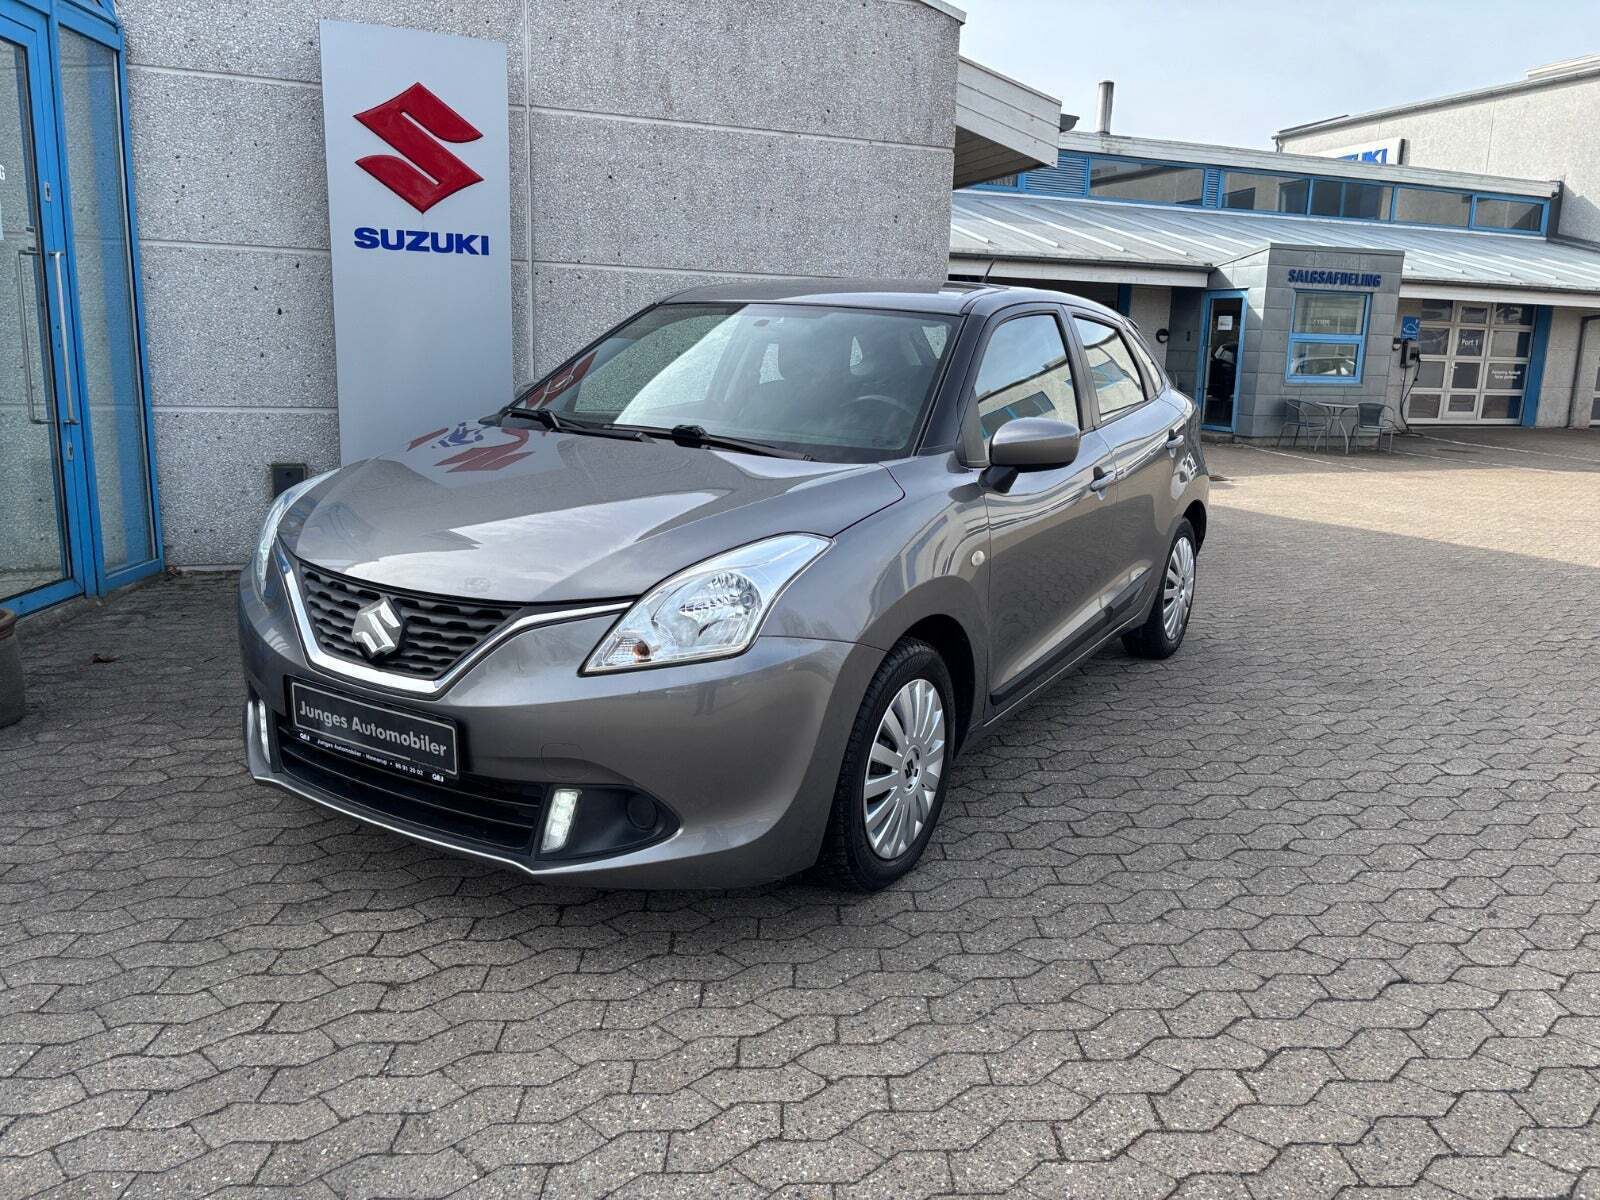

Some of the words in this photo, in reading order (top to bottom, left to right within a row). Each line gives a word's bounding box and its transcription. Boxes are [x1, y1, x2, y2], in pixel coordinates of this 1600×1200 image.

[354, 227, 490, 256] SUZUKI
[1288, 268, 1382, 288] SALGSAFDELING
[1461, 338, 1474, 346] Port
[299, 700, 348, 728] Junges
[352, 716, 447, 756] Automobiler
